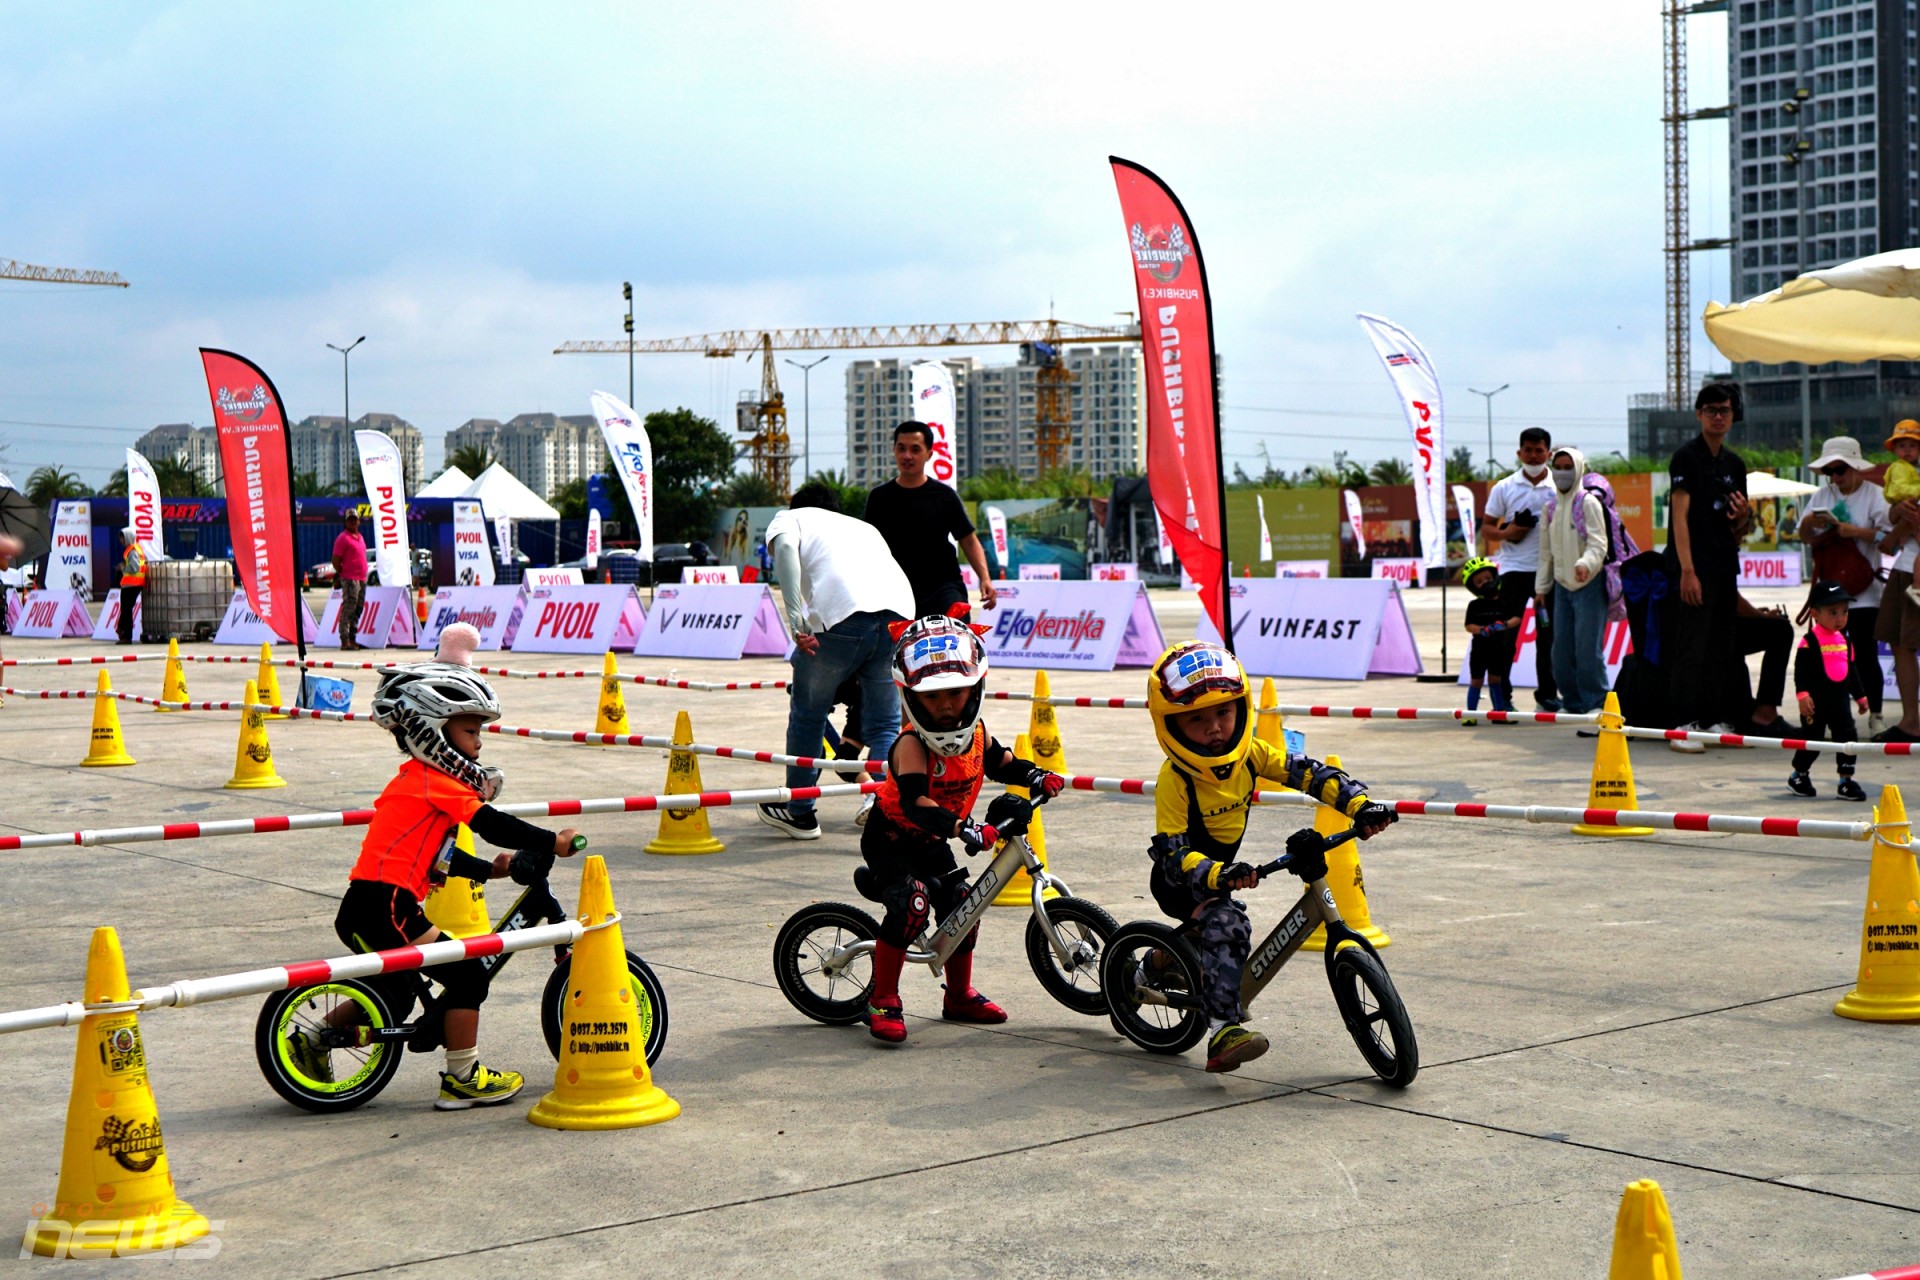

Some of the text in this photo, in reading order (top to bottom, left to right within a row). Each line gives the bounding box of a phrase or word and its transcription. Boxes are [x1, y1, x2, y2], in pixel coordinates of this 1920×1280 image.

[134, 491, 154, 543] PVOIL
[377, 486, 400, 550] PVOIL
[57, 533, 90, 548] PVOIL
[456, 532, 482, 544] PVOIL
[61, 555, 86, 565] VISA
[458, 551, 479, 560] VISA
[1744, 560, 1787, 579] PVOIL
[25, 601, 59, 628] PVOIL
[535, 602, 600, 639] PVOIL
[681, 613, 743, 630] VINFAST
[994, 608, 1107, 651] Ekokemika
[1259, 617, 1361, 640] VINFAST
[955, 869, 999, 928] RIO
[1873, 924, 1918, 937] 037.393.3579
[1250, 907, 1309, 981] STRIDER
[291, 985, 330, 1010] ROCKFISH
[577, 1021, 628, 1035] 037.393.3579
